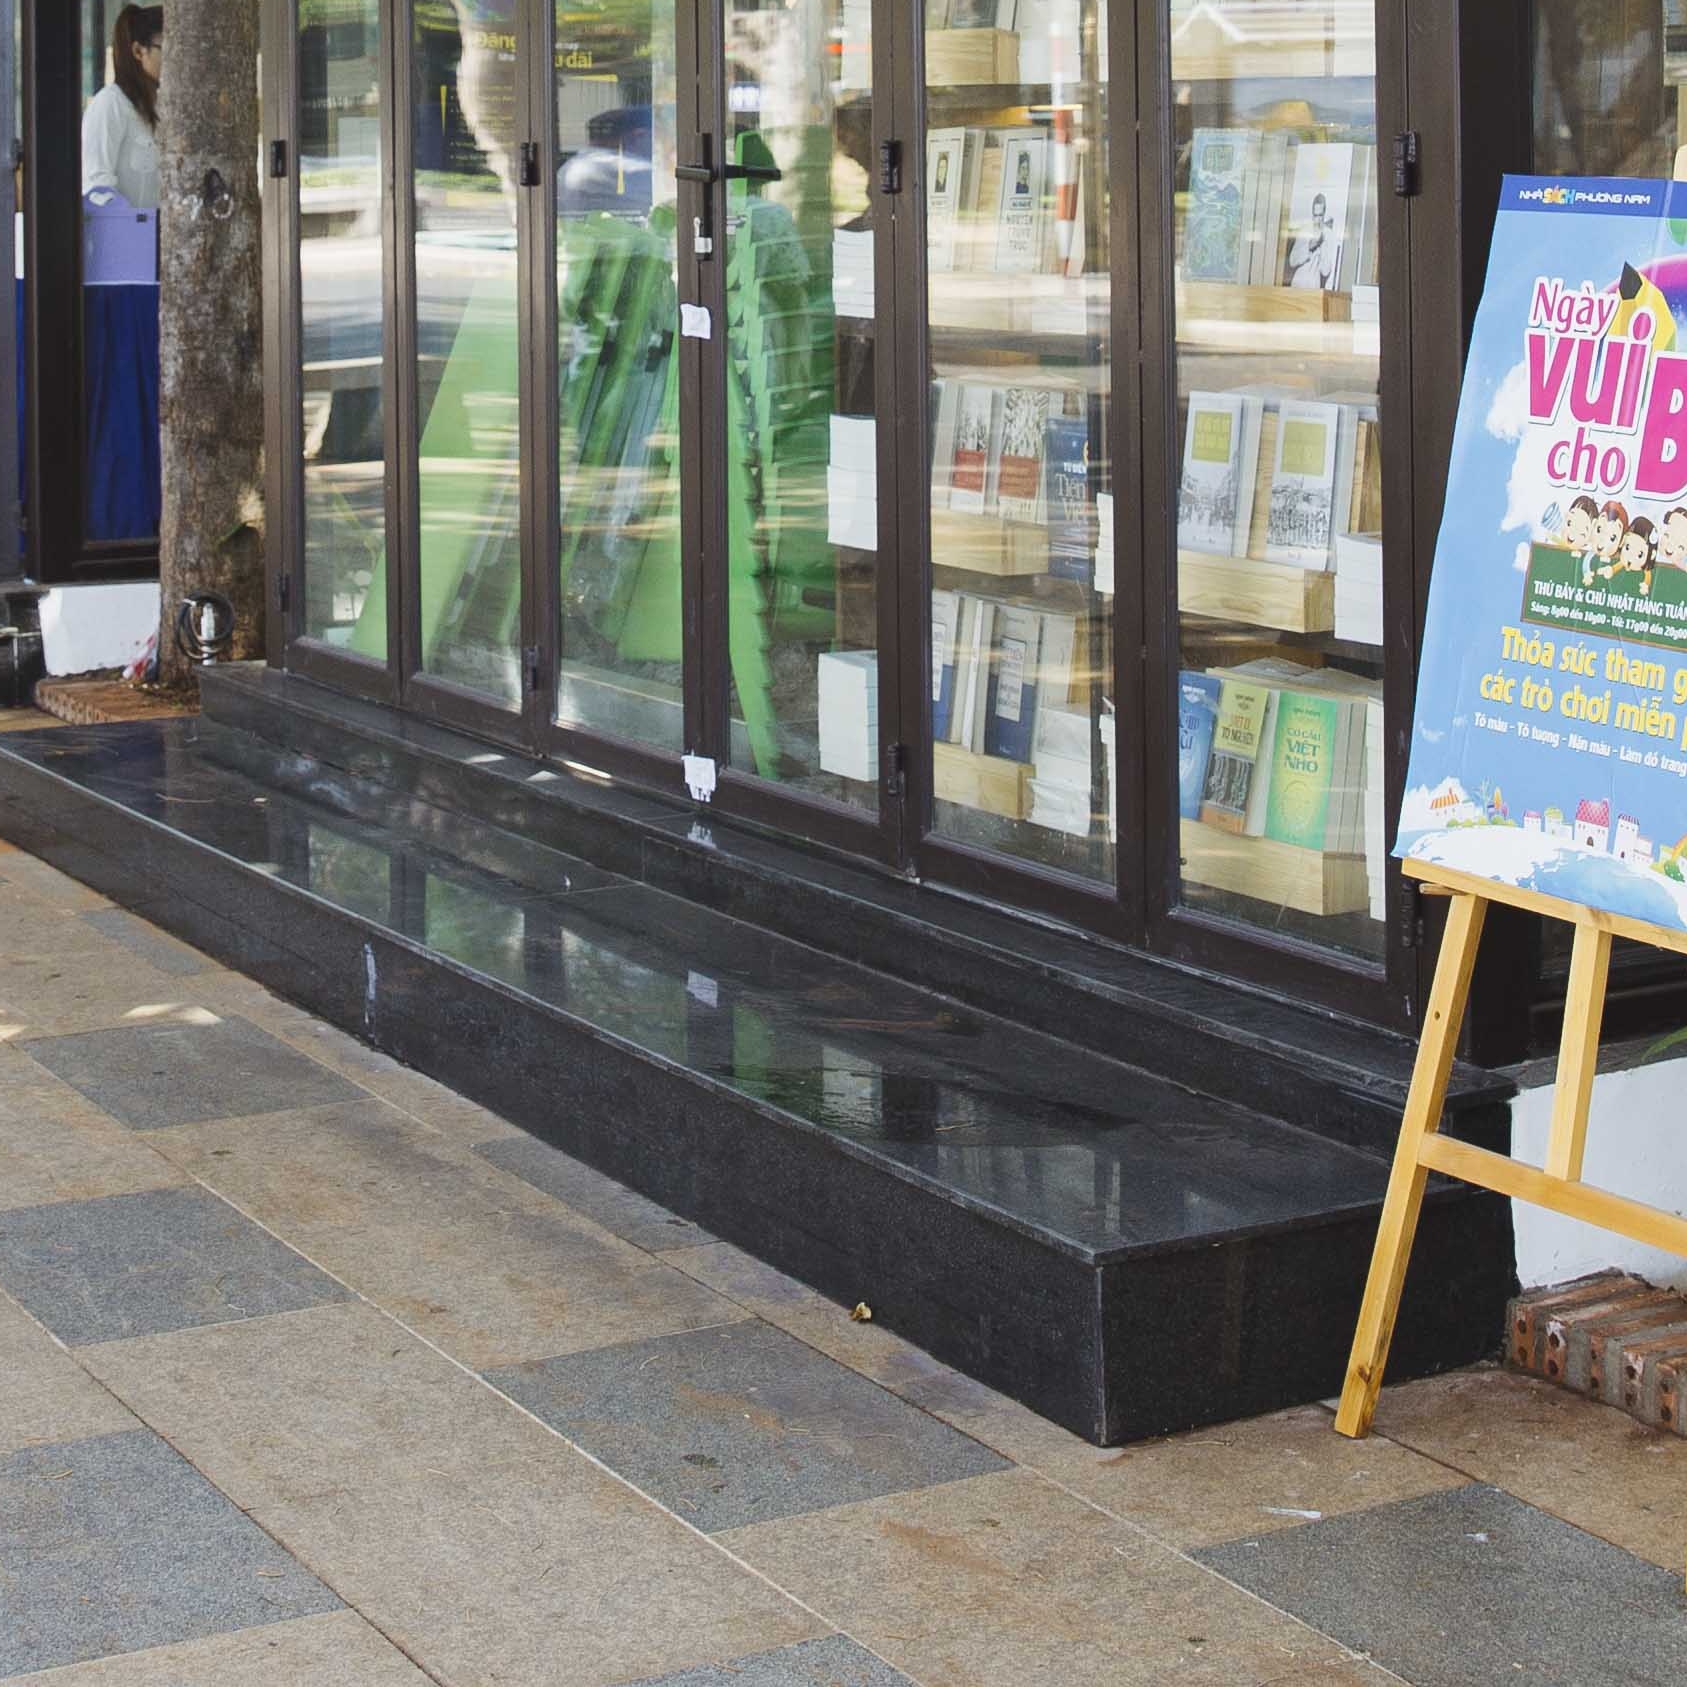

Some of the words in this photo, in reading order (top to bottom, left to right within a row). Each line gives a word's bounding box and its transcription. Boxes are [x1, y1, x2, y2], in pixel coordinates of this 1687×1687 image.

[1519, 188, 1543, 201] NHÀ
[1542, 184, 1576, 205] SÁCH
[1575, 190, 1624, 204] PHƯƠNG
[1624, 194, 1651, 205] NAM
[1532, 281, 1616, 335] Ngày
[1527, 312, 1652, 428] vui
[1546, 427, 1626, 488] cho
[1555, 581, 1576, 599] BẢY
[1575, 589, 1584, 602] &
[1585, 587, 1607, 605] CHỦ
[1607, 592, 1634, 613] NHẬT
[1635, 596, 1664, 617] HÀNG
[1501, 626, 1556, 669] Thỏa
[1605, 648, 1667, 692] tham
[1479, 668, 1517, 704] các
[1520, 675, 1555, 713] trò
[1614, 695, 1677, 740] miễn
[1619, 745, 1644, 764] Làm
